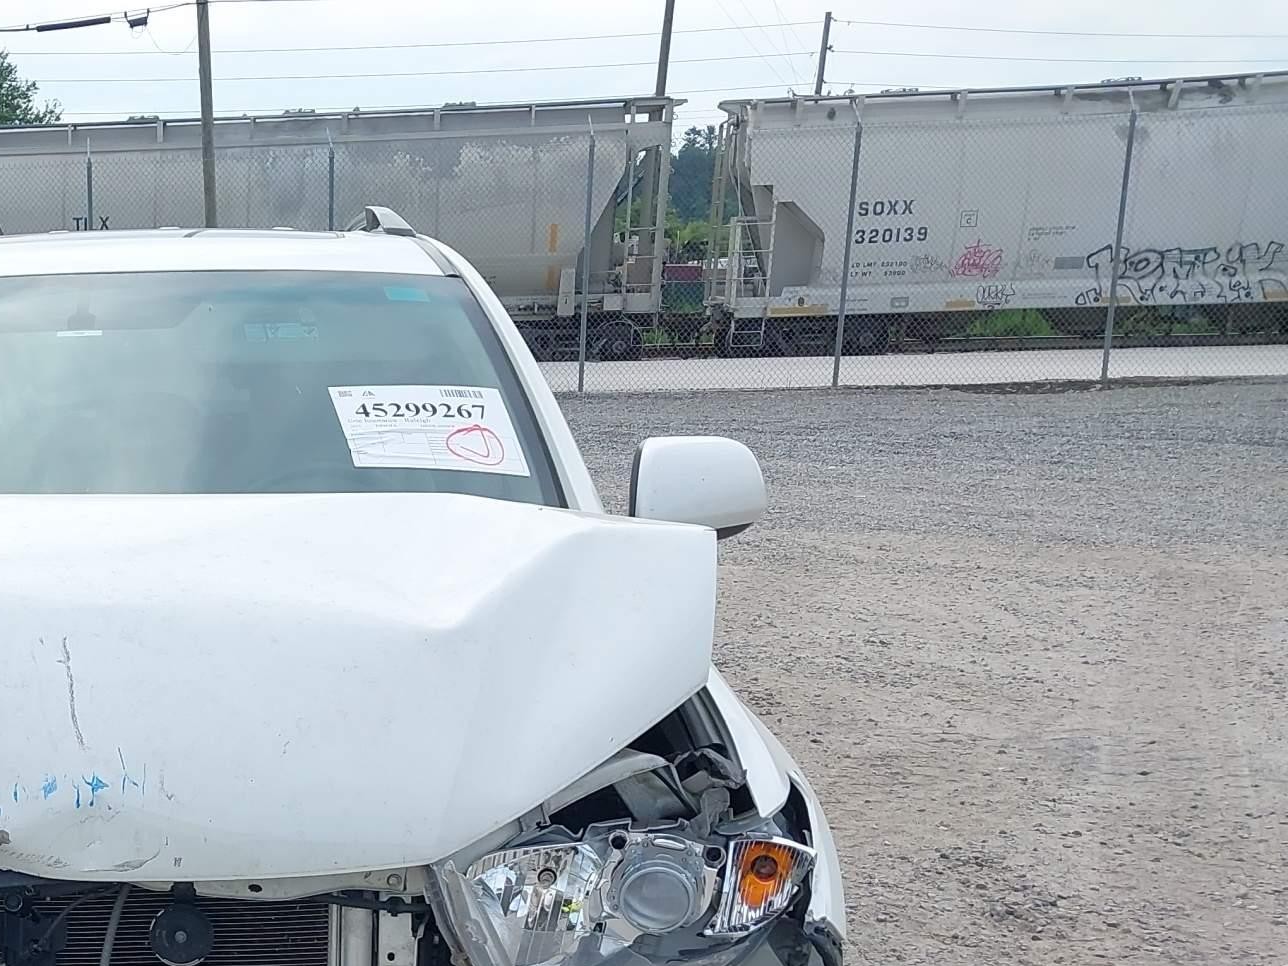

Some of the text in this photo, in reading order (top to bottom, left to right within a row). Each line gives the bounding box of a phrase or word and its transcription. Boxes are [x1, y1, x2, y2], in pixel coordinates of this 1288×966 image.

[857, 200, 915, 217] SOXX
[854, 226, 929, 245] 320139
[355, 402, 485, 419] 45299267
